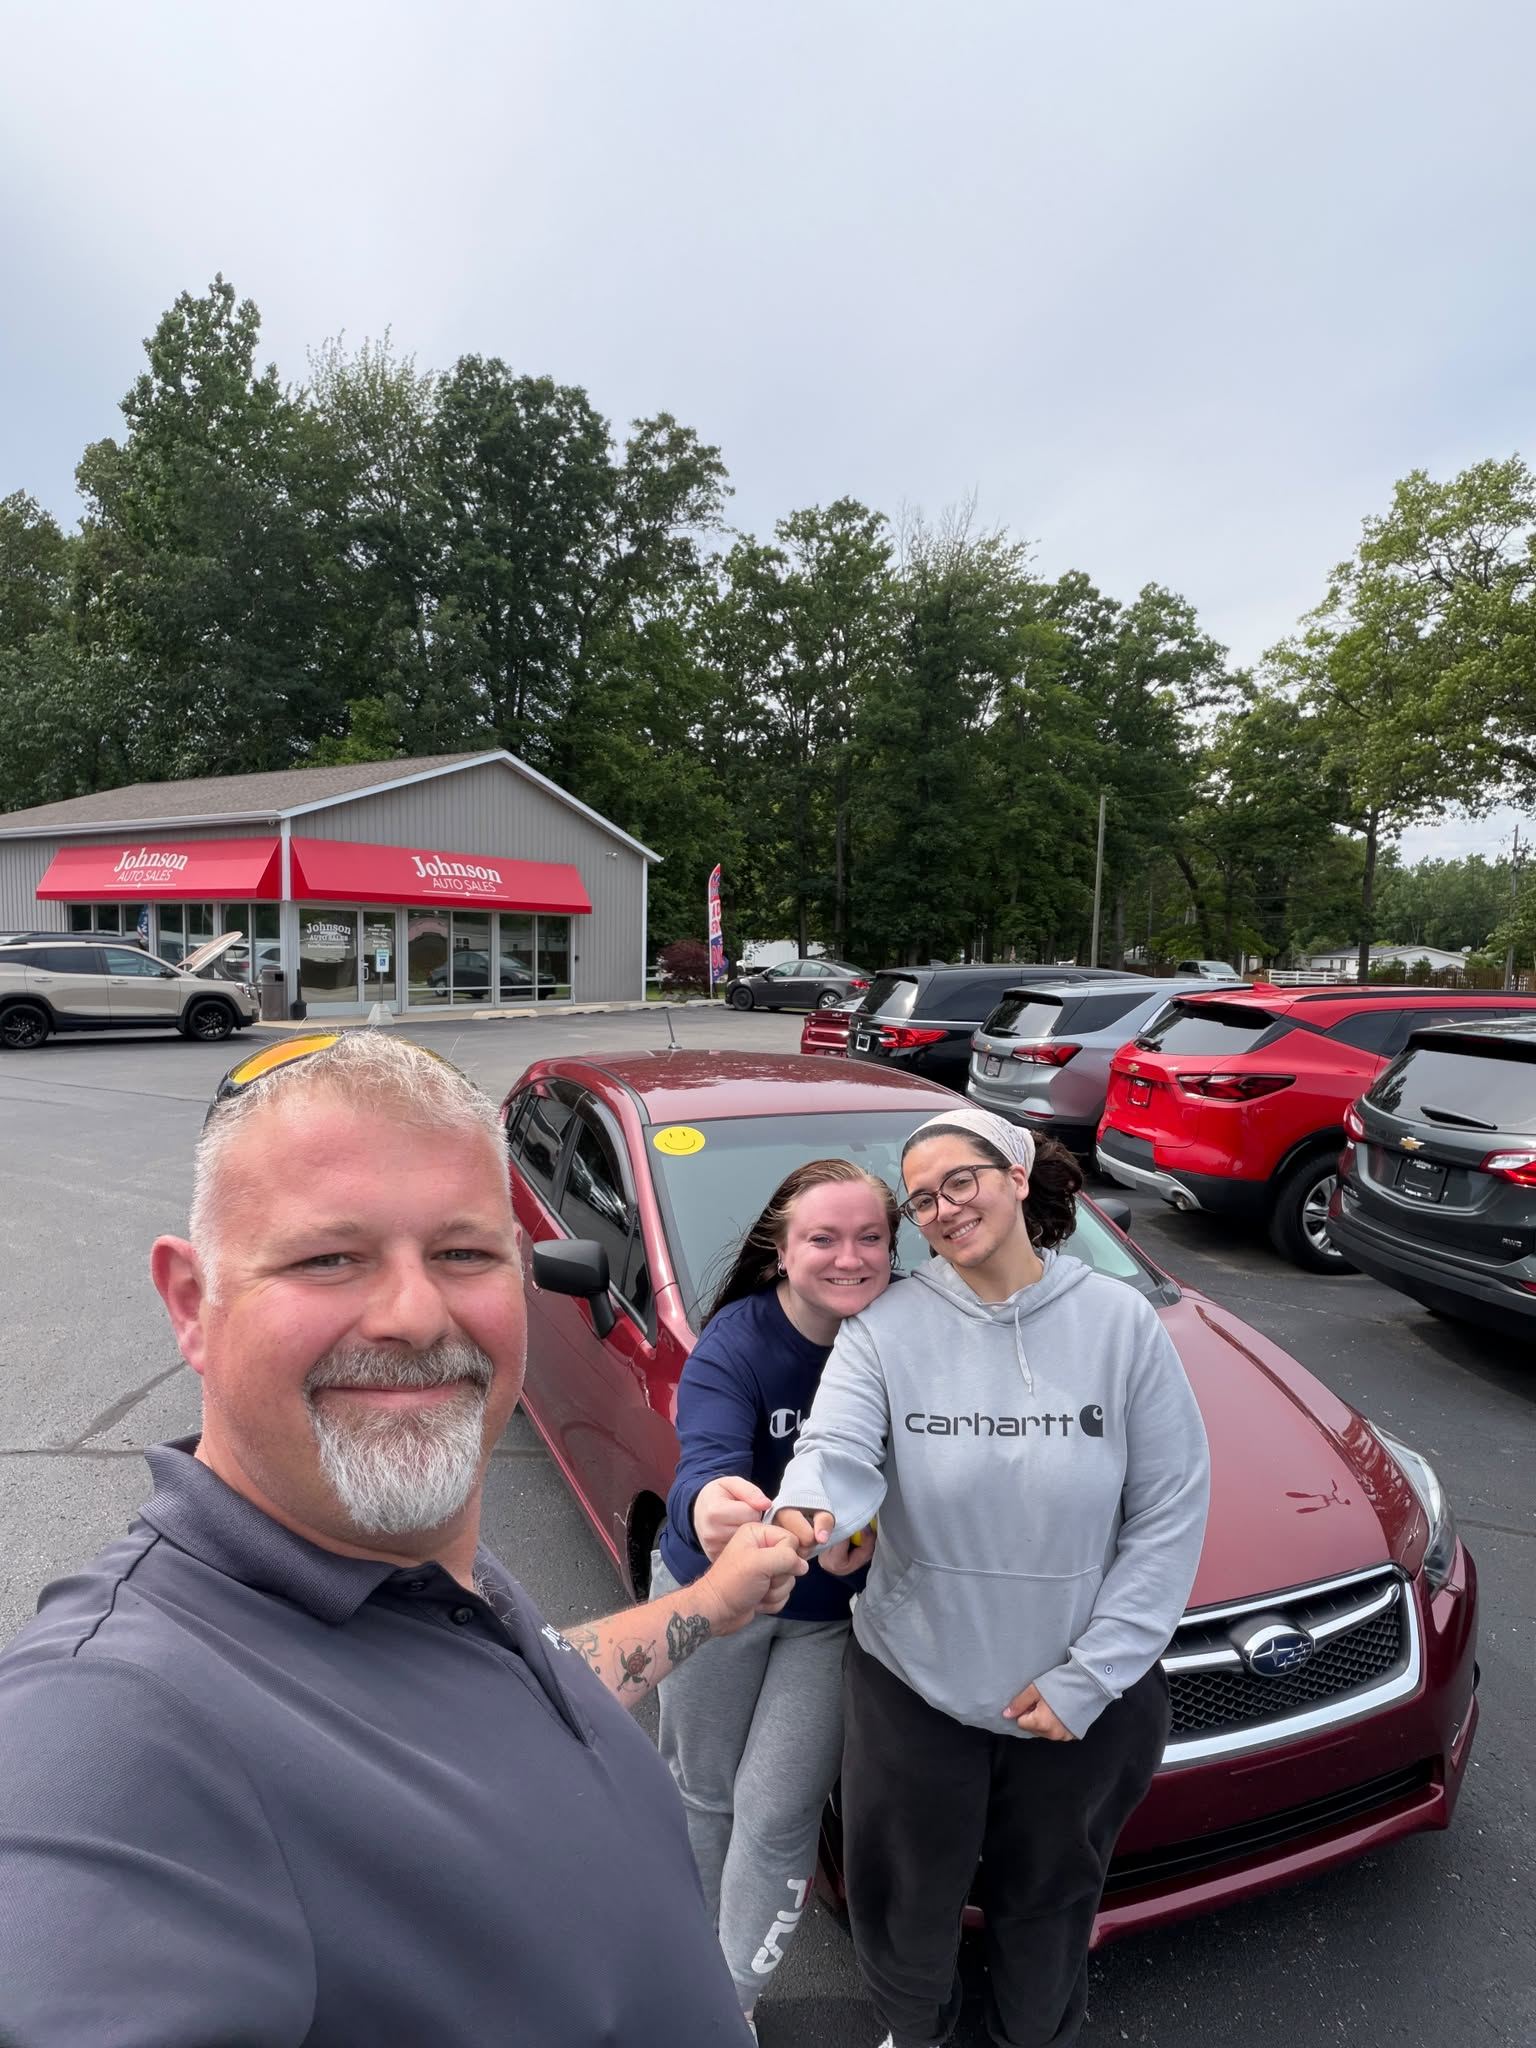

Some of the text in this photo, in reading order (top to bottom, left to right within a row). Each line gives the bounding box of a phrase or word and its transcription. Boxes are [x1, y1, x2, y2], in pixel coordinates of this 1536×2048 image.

[114, 847, 188, 872] Johnson
[411, 855, 503, 884] Johnson
[118, 870, 173, 881] AUTO SALES
[433, 878, 496, 893] AUTO SALES
[306, 921, 351, 935] Johnson
[904, 1412, 1074, 1437] carhartt
[750, 1876, 814, 1974] FILA
